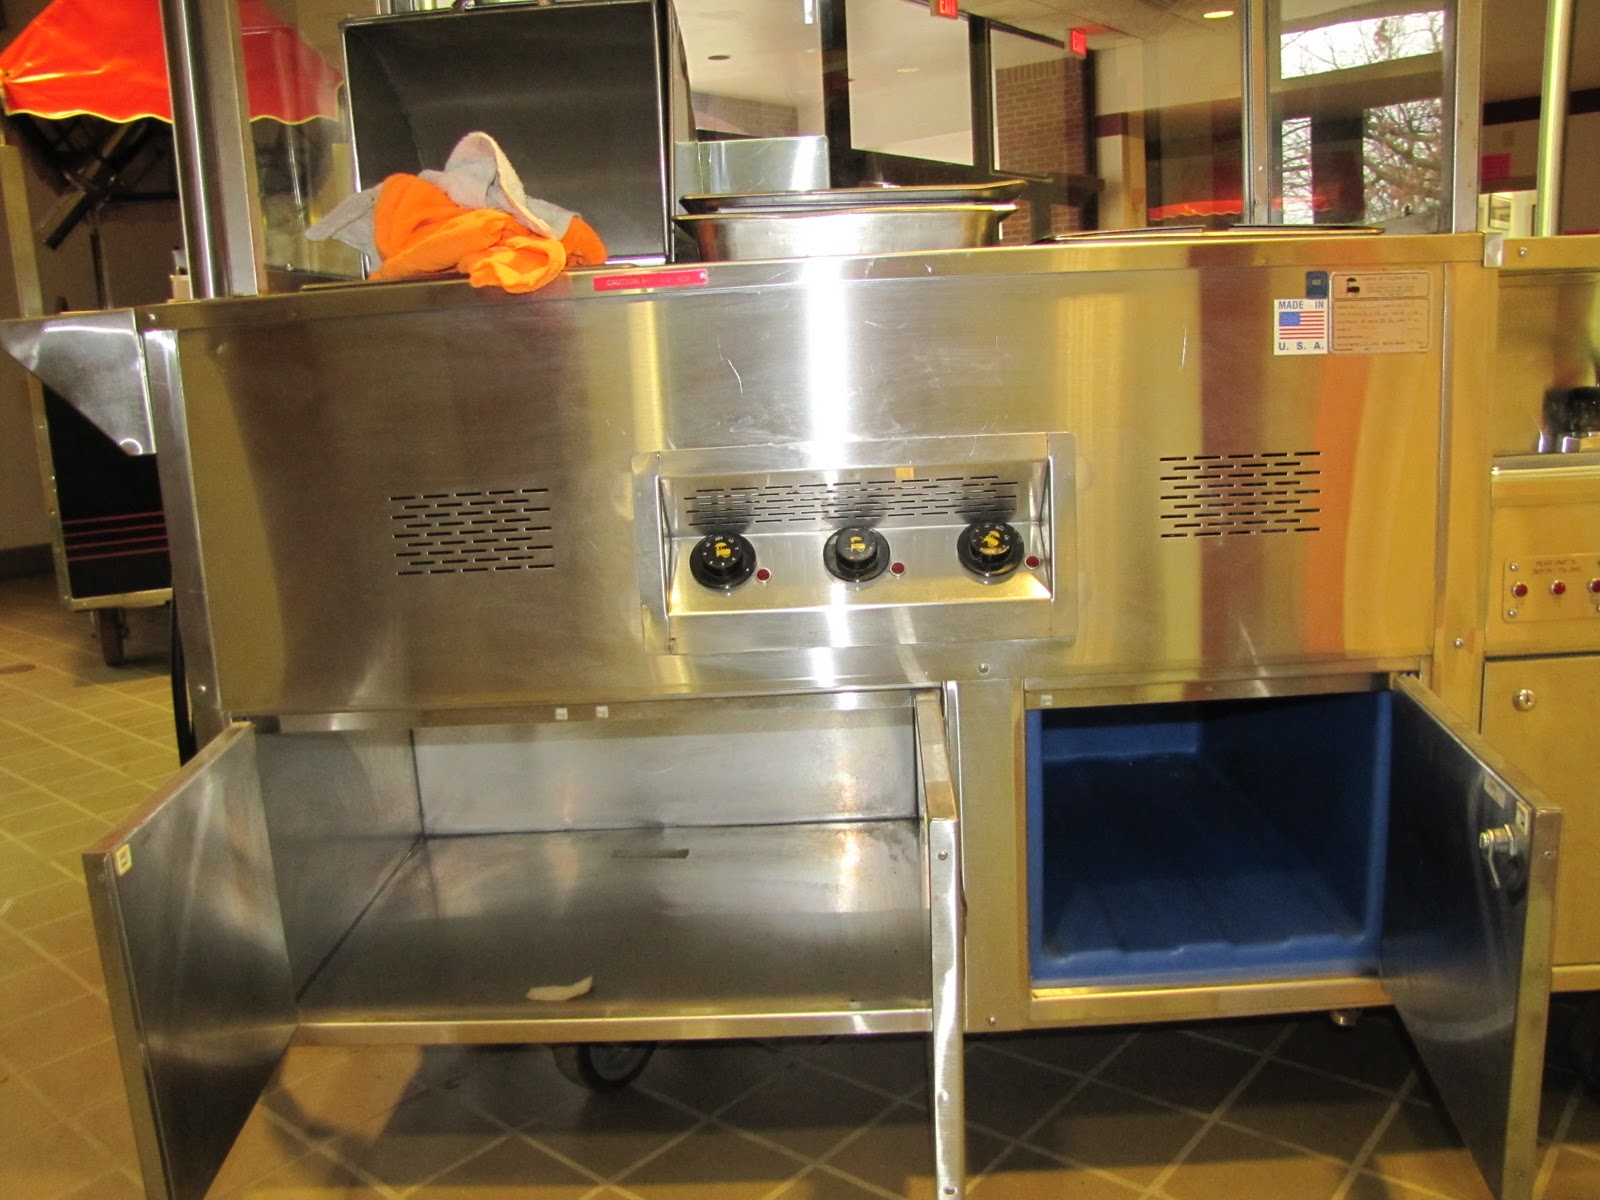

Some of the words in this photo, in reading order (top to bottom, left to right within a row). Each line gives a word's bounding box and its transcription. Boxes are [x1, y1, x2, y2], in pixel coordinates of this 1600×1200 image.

[1278, 300, 1304, 310] MADE
[1315, 300, 1324, 309] IN
[1278, 342, 1289, 351] U.
[1296, 341, 1306, 350] S.
[1313, 341, 1325, 350] A.
